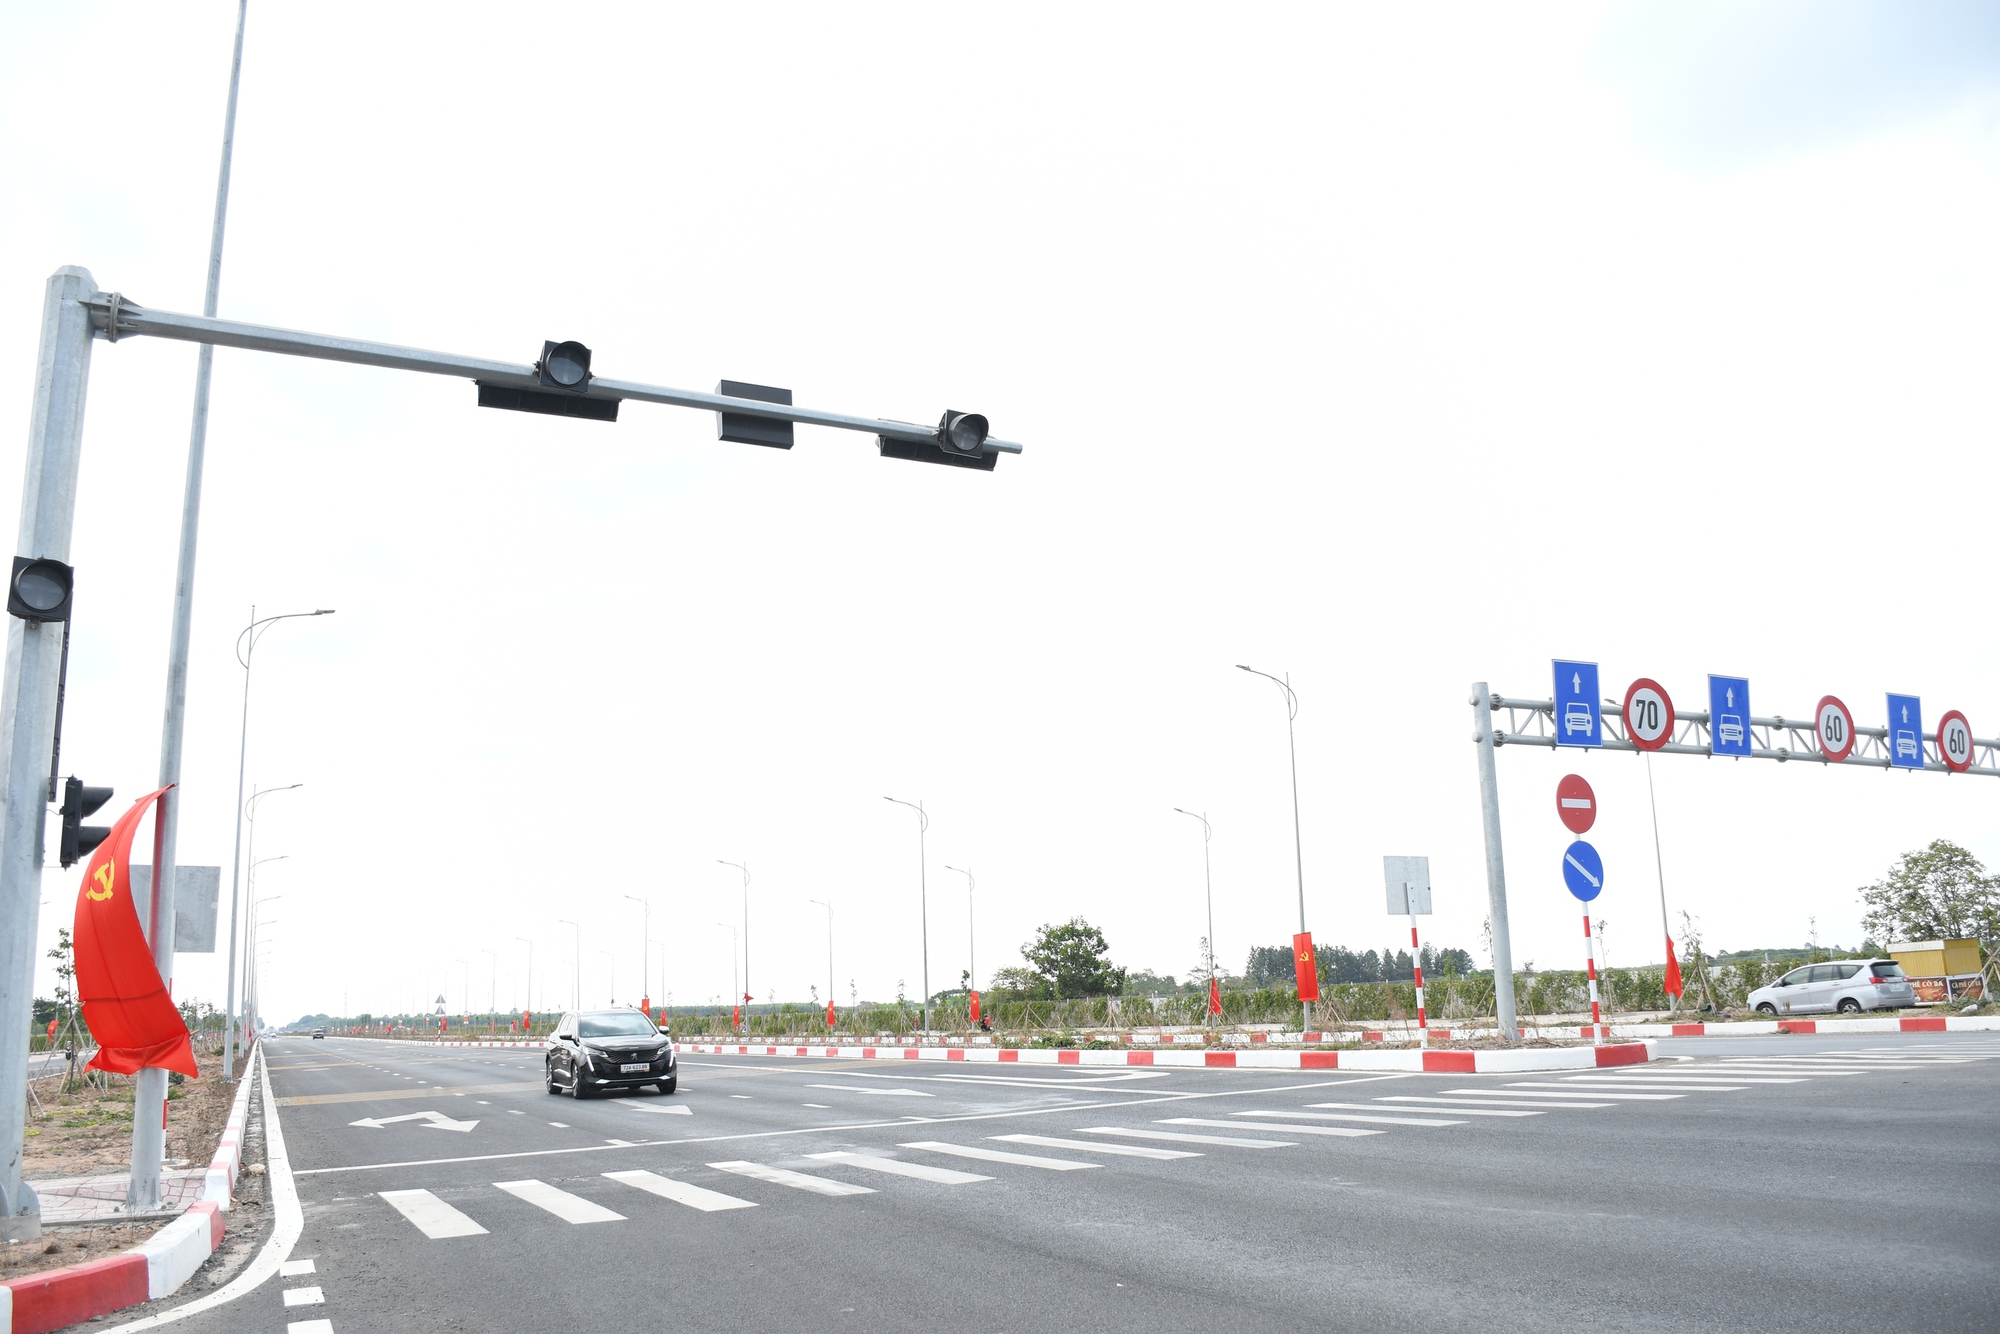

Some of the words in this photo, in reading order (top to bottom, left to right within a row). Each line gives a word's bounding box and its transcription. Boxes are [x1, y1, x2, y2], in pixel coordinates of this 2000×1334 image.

[1635, 699, 1658, 731] 70
[1825, 714, 1843, 743] 60
[1949, 728, 1965, 755] 60
